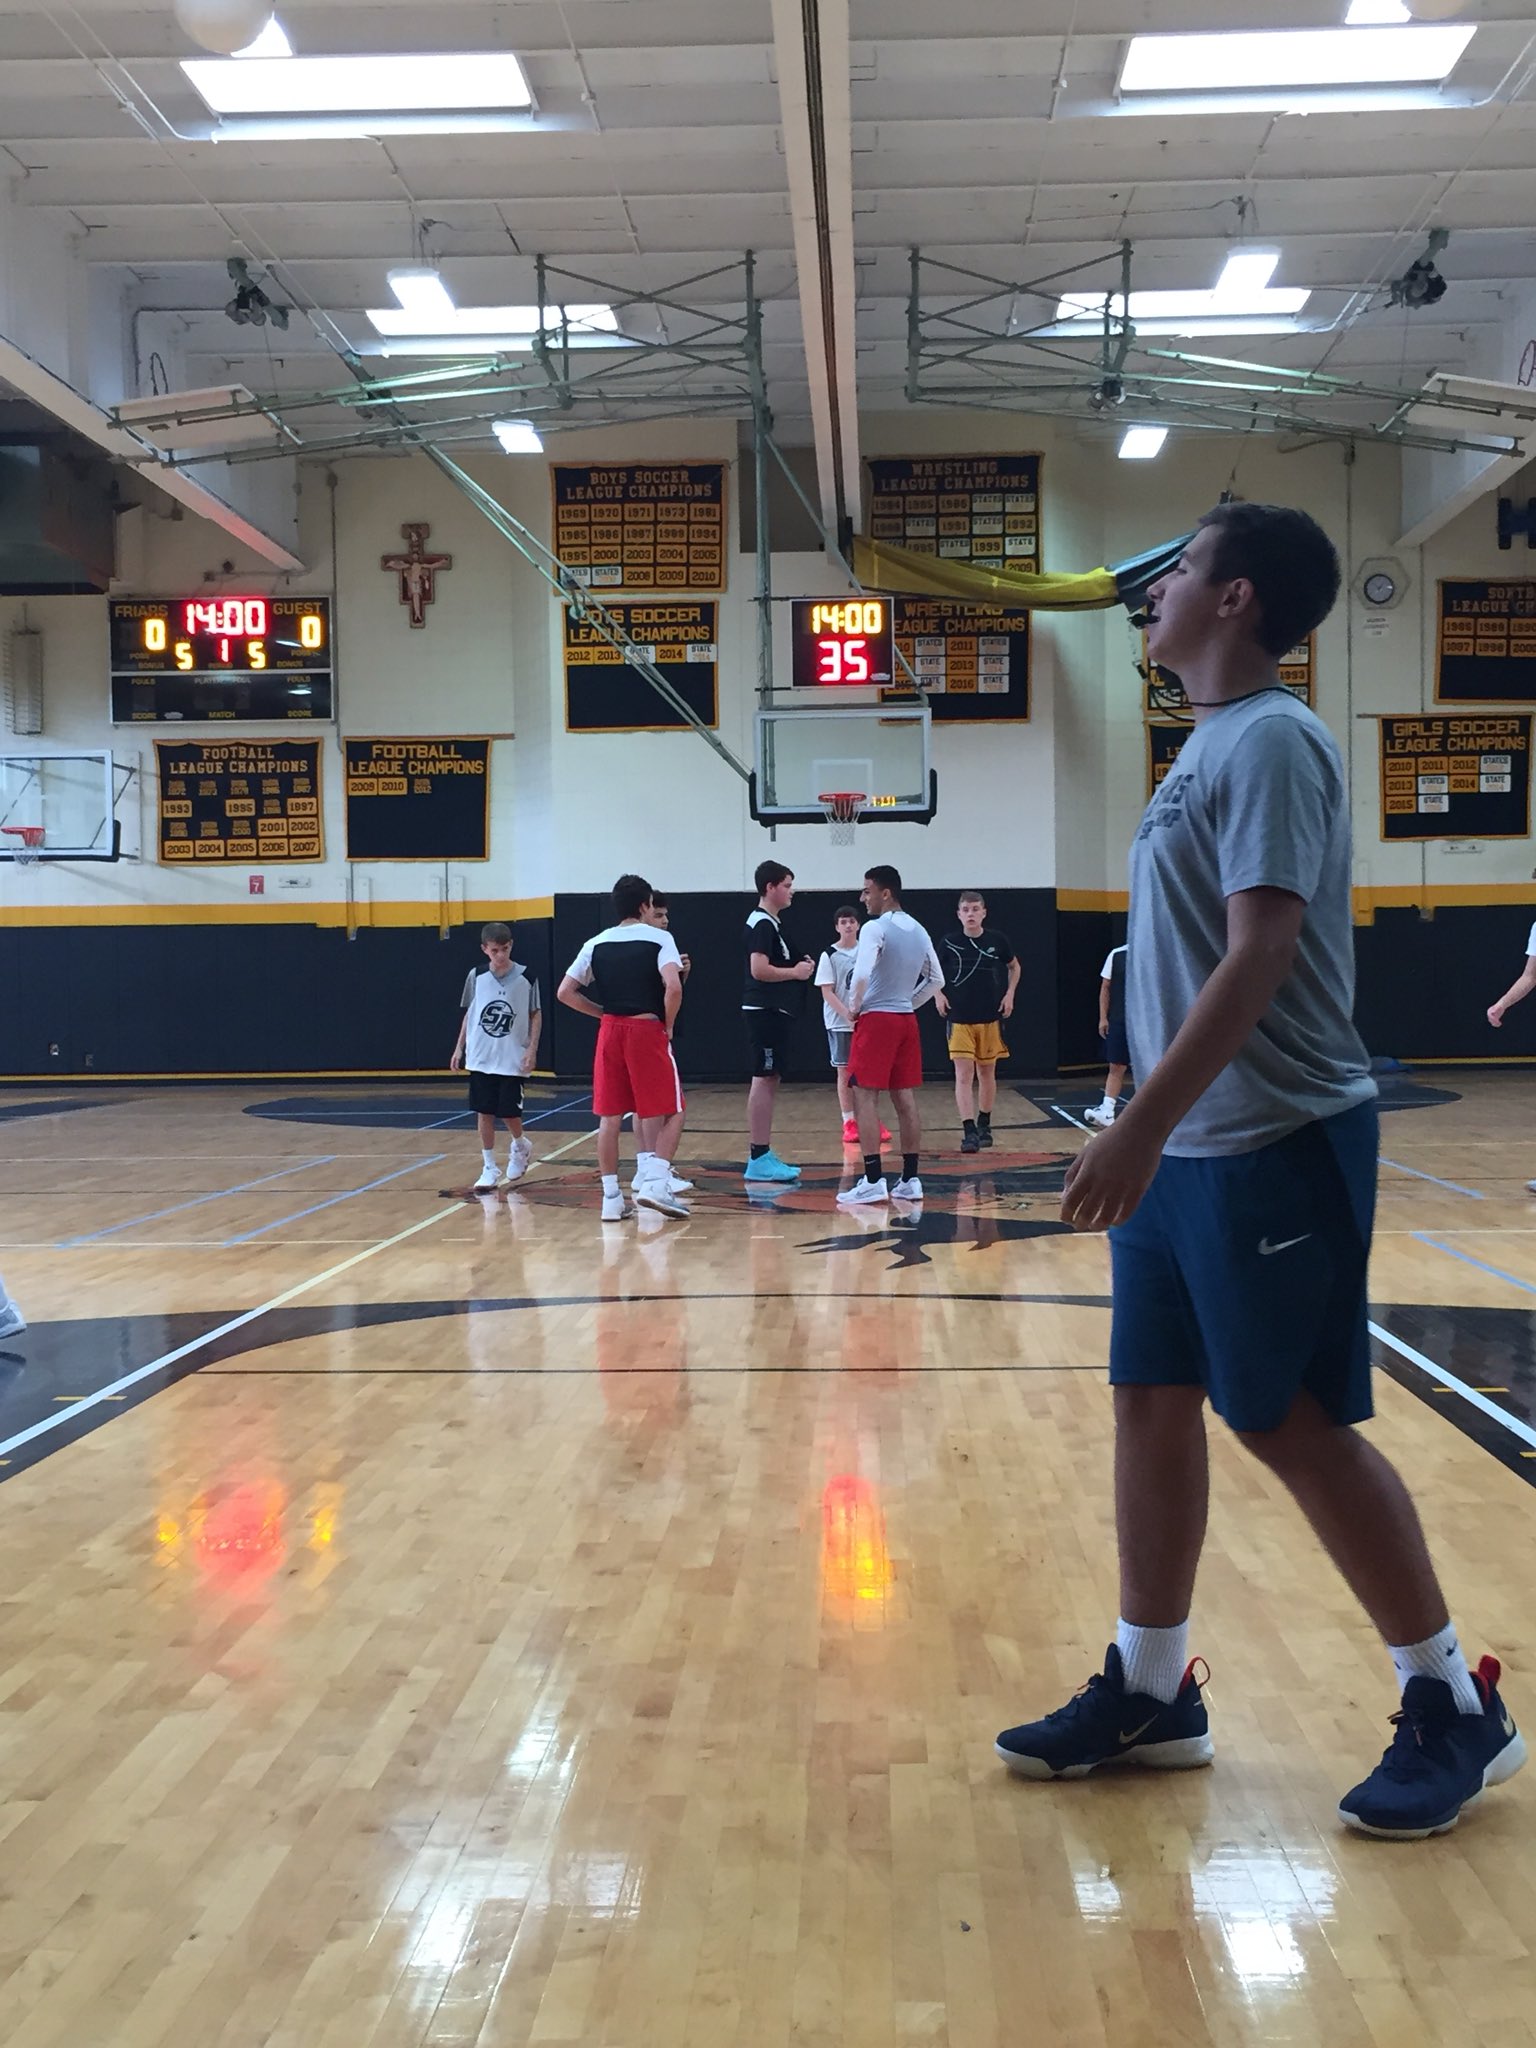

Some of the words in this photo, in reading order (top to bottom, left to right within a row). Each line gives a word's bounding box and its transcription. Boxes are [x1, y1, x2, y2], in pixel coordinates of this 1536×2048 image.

[912, 462, 998, 476] WRESTLING
[590, 472, 627, 485] BOYS
[635, 471, 689, 484] SOCCER
[881, 478, 937, 491] LEAGUE
[944, 475, 1029, 489] CHAMPIONS
[567, 486, 623, 500] LEAGUE
[629, 484, 712, 498] CHAMPIONS
[593, 549, 619, 560] 2000
[659, 548, 684, 559] 2004
[692, 549, 717, 560] 2005
[692, 571, 715, 581] 2010
[115, 605, 168, 618] FRIARS
[273, 602, 322, 615] GUEST
[1452, 600, 1509, 613] LEAGUE
[186, 600, 266, 635] 14:00
[631, 608, 700, 623] SOCCER
[812, 603, 881, 634] 14:00
[301, 616, 322, 648] 0
[894, 619, 940, 634] EAGUE
[945, 617, 1025, 633] CHAMPIONS
[145, 618, 166, 651] 0
[632, 626, 710, 641] CHAMPIONS
[221, 639, 229, 662] 1
[950, 641, 973, 650] 2011
[175, 643, 193, 670] 5
[248, 641, 266, 669] 5
[567, 651, 590, 661] 2012
[597, 650, 621, 660] 2013
[659, 649, 683, 659] 2014
[818, 640, 868, 682] 35
[950, 660, 974, 670] 2013
[208, 711, 236, 719] MATCH
[1393, 722, 1444, 736] GIRLS
[1449, 720, 1520, 735] SOCCER
[372, 744, 462, 759] FOOTBALL
[1386, 738, 1442, 753] LEAGUE
[1447, 736, 1526, 751] CHAMPIONS
[203, 747, 275, 760] FOOTBALL
[170, 762, 224, 774] LEAGUE
[229, 760, 309, 773] CHAMPIONS
[349, 761, 404, 775] LEAGUE
[408, 760, 484, 774] CHAMPIONS
[1422, 760, 1444, 770] 2011
[1452, 760, 1476, 770] 2012
[351, 782, 375, 791] 2009
[381, 781, 404, 791] 2010
[1452, 778, 1476, 788] 2014
[260, 822, 285, 832] 2001
[291, 821, 316, 831] 2002
[167, 844, 191, 854] 2003
[198, 843, 221, 853] 2004
[229, 843, 254, 853] 2005
[262, 842, 285, 852] 2006
[293, 841, 316, 851] 2007
[482, 1005, 513, 1033] SA
